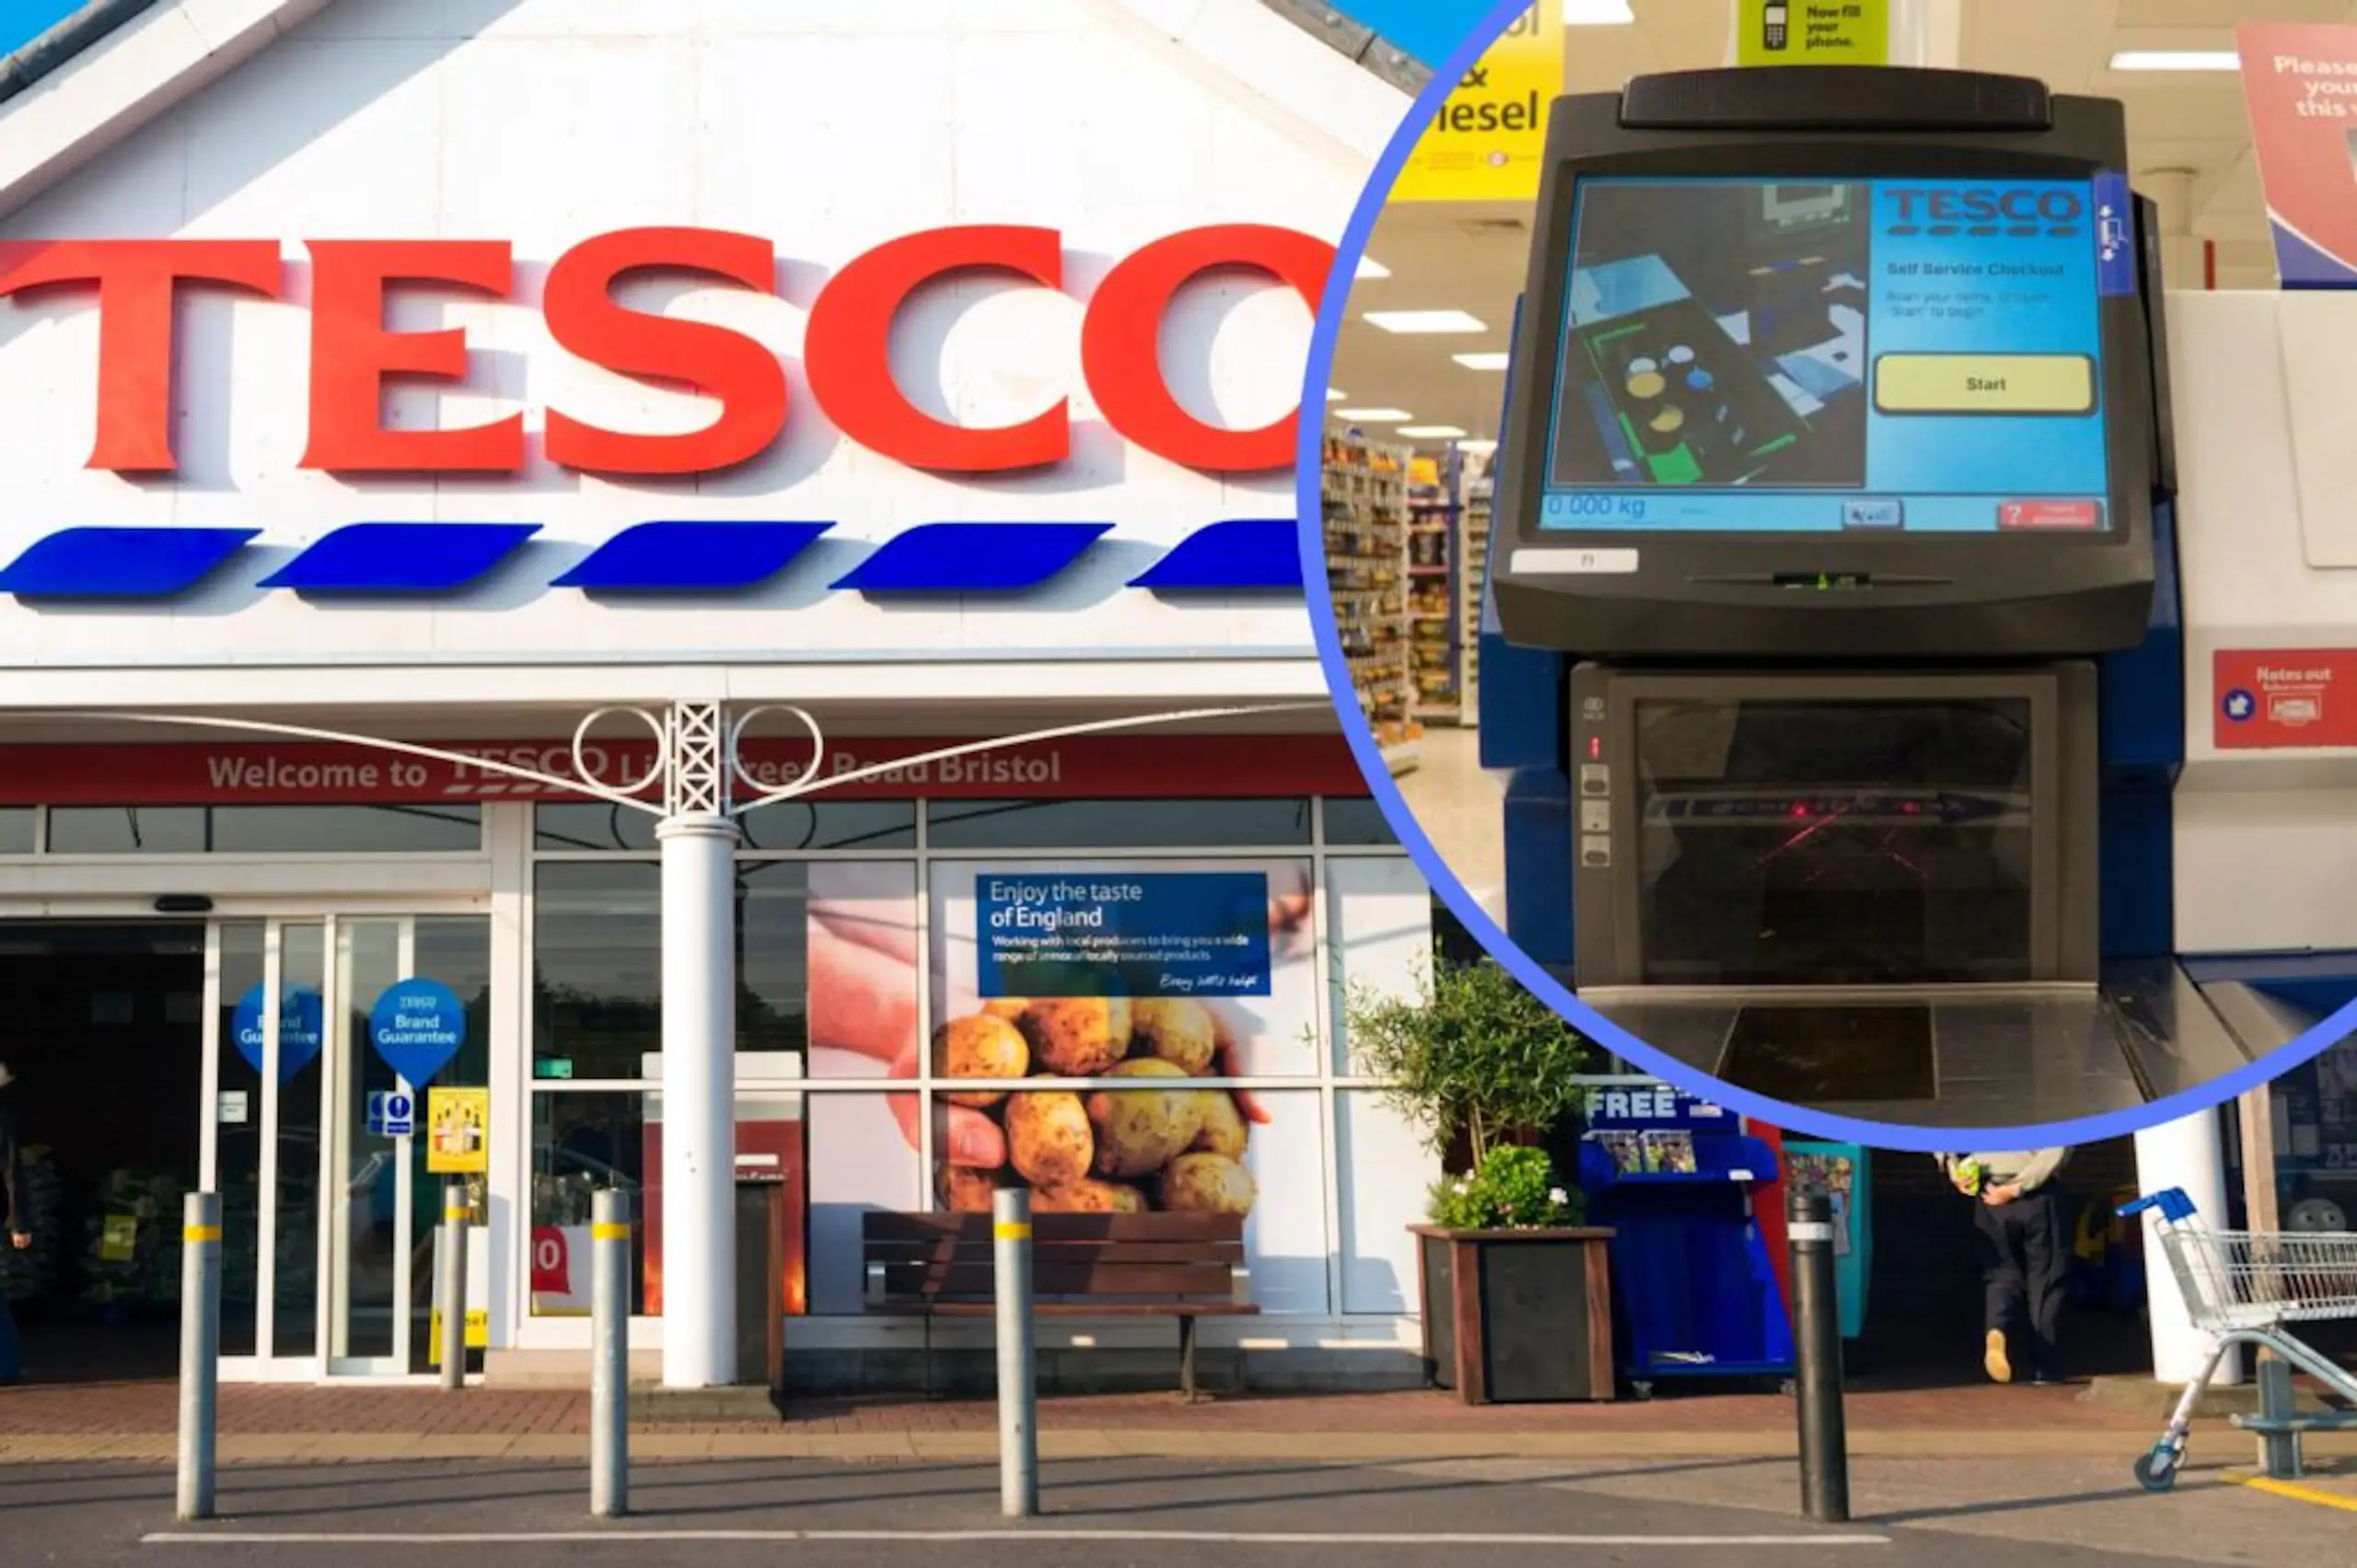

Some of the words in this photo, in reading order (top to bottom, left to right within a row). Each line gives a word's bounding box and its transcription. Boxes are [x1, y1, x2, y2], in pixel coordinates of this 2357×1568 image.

[1805, 22, 1839, 35] your
[1438, 89, 1538, 132] iesel
[2295, 98, 2347, 117] this
[1884, 188, 2082, 223] TESCO
[1887, 262, 1919, 276] Self
[1923, 262, 1981, 276] Service
[1987, 262, 2065, 276] Checkout
[0, 223, 1338, 473] TESCO
[1966, 377, 2006, 391] Start
[1619, 495, 1646, 519] kg
[2256, 666, 2303, 682] Notes
[2305, 668, 2333, 682] out
[207, 756, 379, 788] Welcome
[389, 759, 427, 788] to
[451, 746, 610, 780] TESCO
[735, 752, 821, 784] rees
[832, 751, 929, 784] Road
[938, 750, 1061, 784] Bristol
[990, 880, 1049, 906] Enjoy
[1051, 880, 1087, 902] the
[1090, 883, 1144, 902] taste
[990, 906, 1015, 928] of
[1016, 906, 1103, 932] England
[395, 1013, 441, 1028] Brand
[377, 1028, 457, 1045] Guarantee
[1585, 1090, 1678, 1119] FREE
